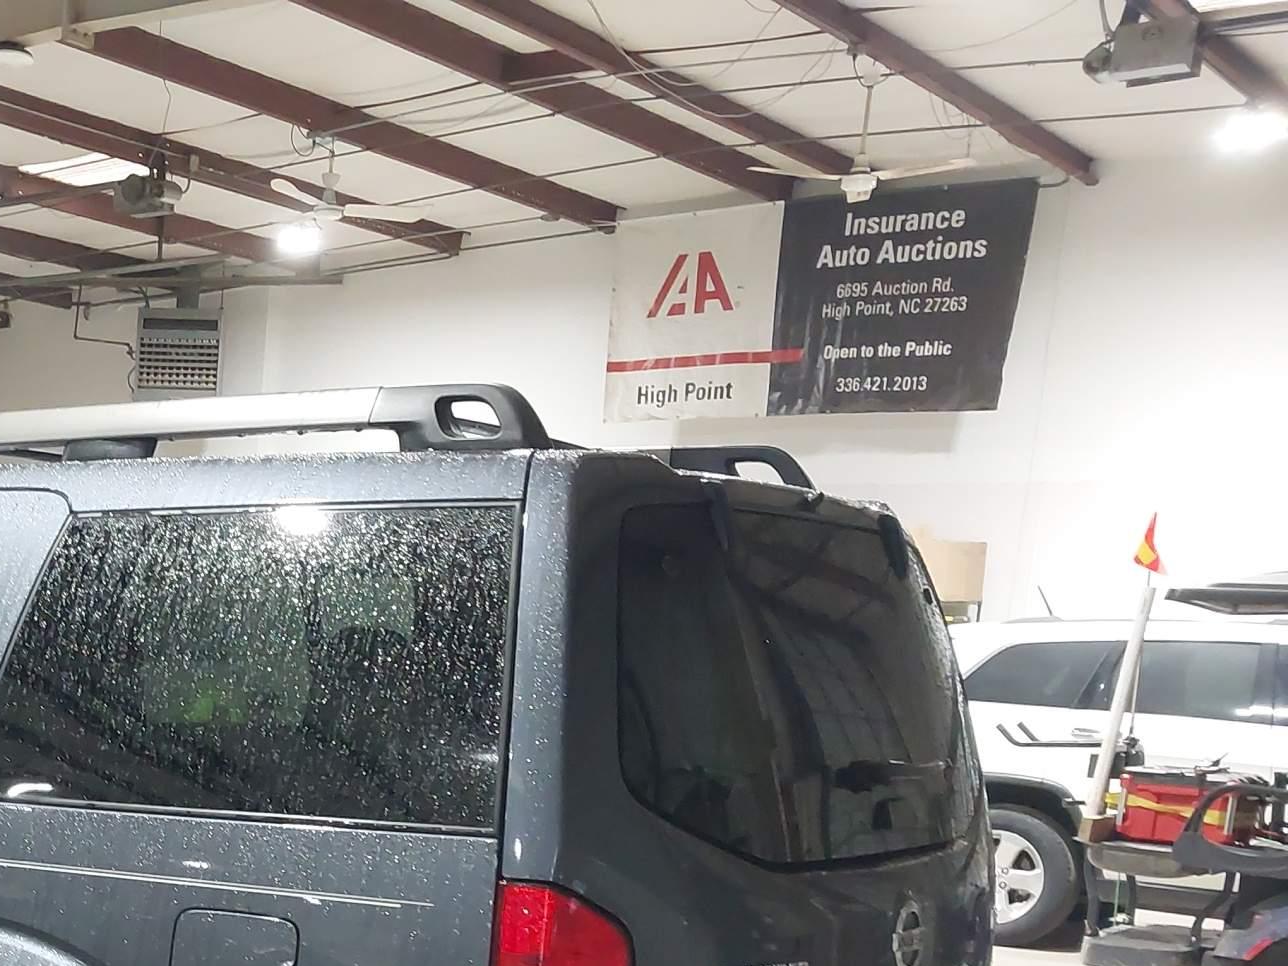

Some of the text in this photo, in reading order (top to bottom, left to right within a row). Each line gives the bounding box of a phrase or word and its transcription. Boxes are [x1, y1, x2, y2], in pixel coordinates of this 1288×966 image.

[844, 209, 966, 236] Insurance
[816, 236, 988, 269] Auto Auctions
[836, 277, 954, 299] 6695 Auction Rd.
[822, 296, 968, 321] High Point, NC 27263
[823, 340, 952, 361] Open to the Public
[637, 381, 733, 408] High Point
[835, 376, 928, 392] 336.421.2013
